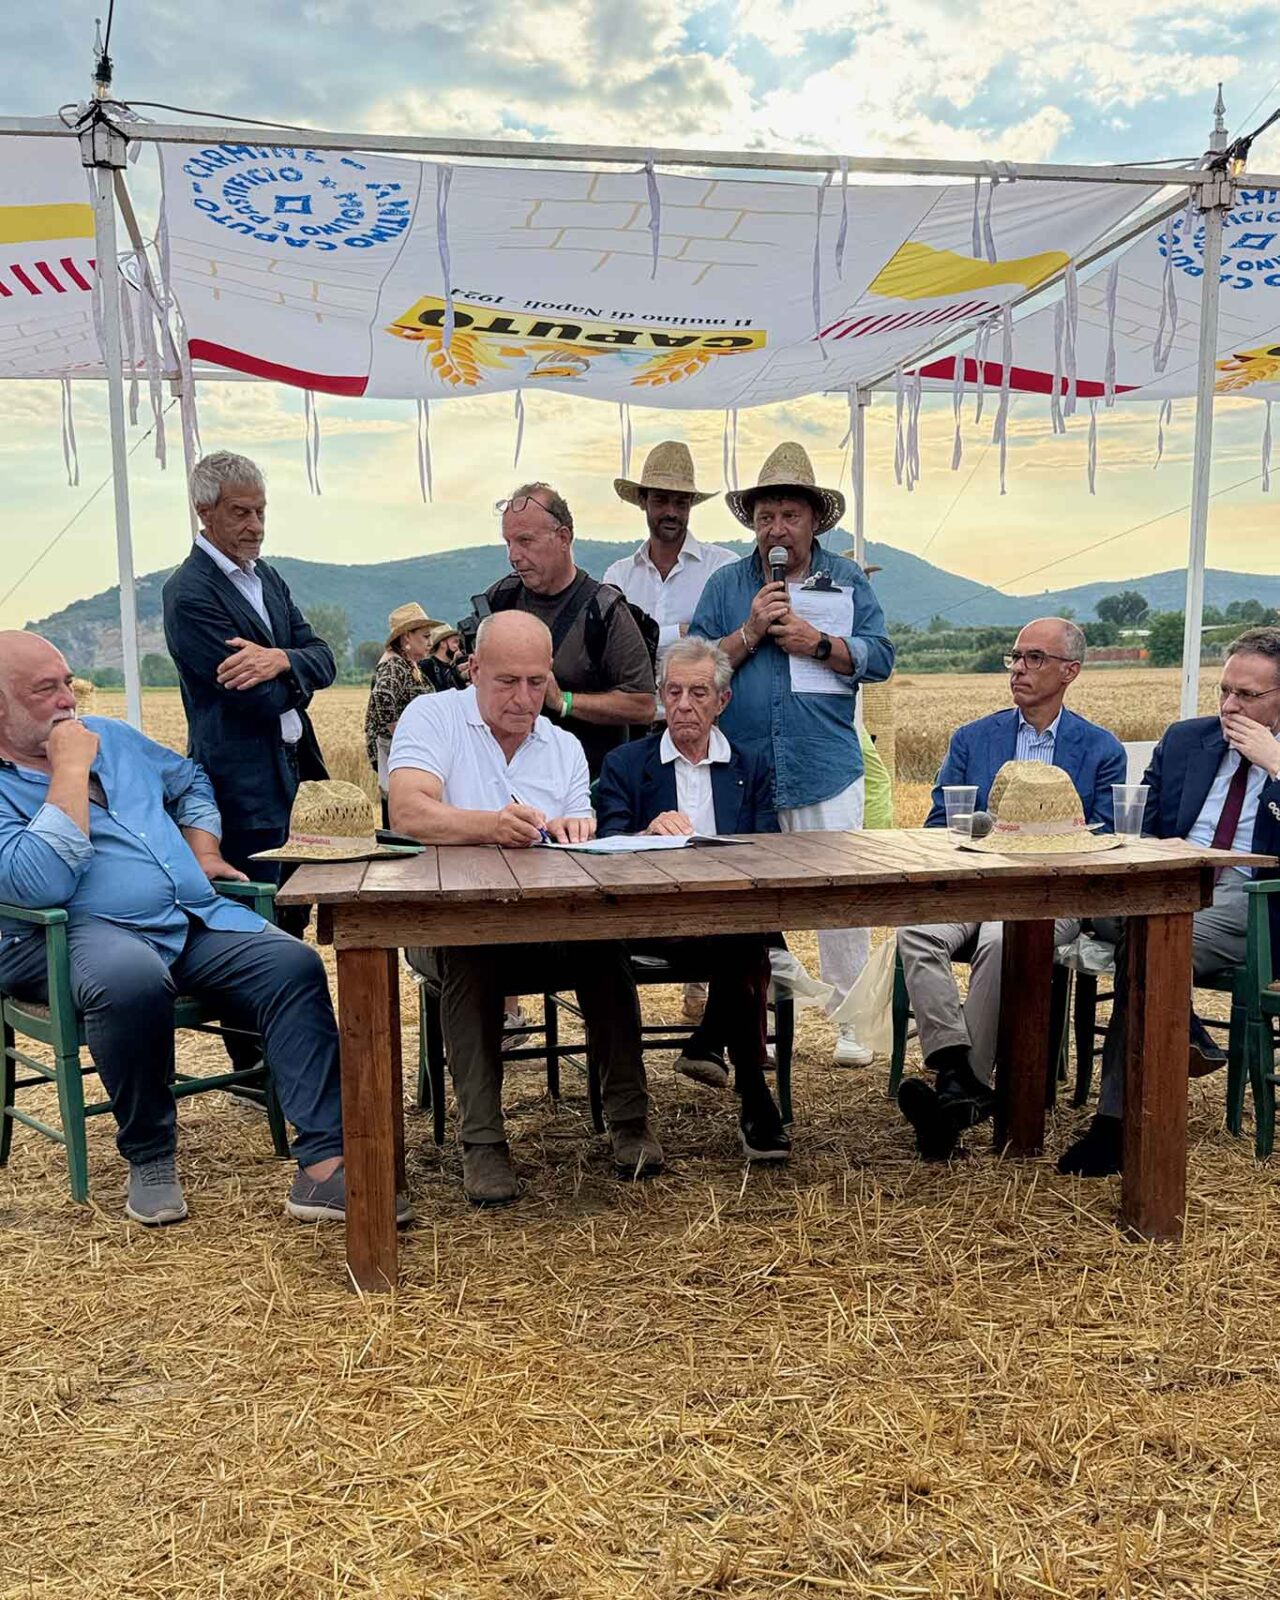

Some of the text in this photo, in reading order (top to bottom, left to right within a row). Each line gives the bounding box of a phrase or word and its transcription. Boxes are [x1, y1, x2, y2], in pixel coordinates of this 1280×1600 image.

[222, 166, 304, 225] PASTIFICIO
[193, 198, 338, 251] CAPUTO
[450, 288, 505, 303] 1924
[522, 299, 602, 317] Napoli
[610, 310, 635, 321] di
[641, 313, 727, 326] mulino
[734, 318, 753, 327] Il
[417, 308, 754, 348] CAPUTO
